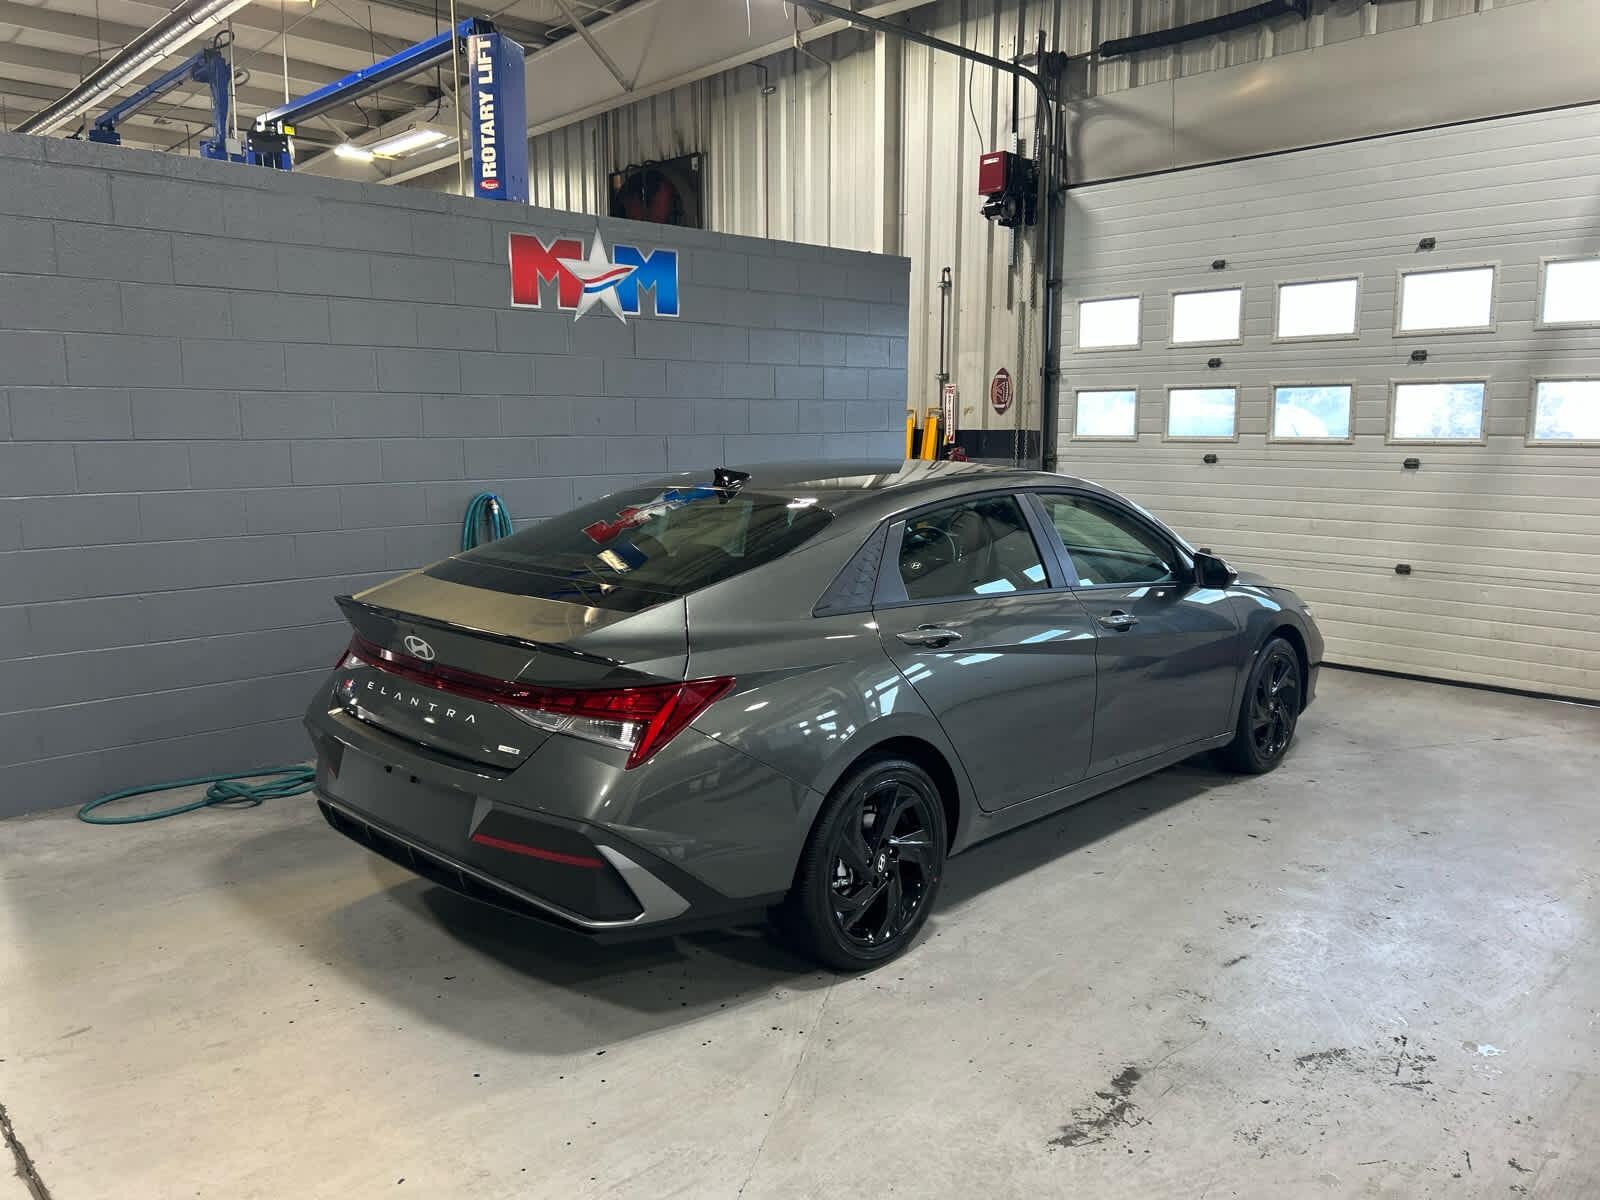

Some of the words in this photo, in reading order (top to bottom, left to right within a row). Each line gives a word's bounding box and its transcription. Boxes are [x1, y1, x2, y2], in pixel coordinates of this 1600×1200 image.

[477, 37, 494, 84] LIFT
[479, 91, 497, 178] ROTARY
[367, 681, 476, 724] ELANTRA
